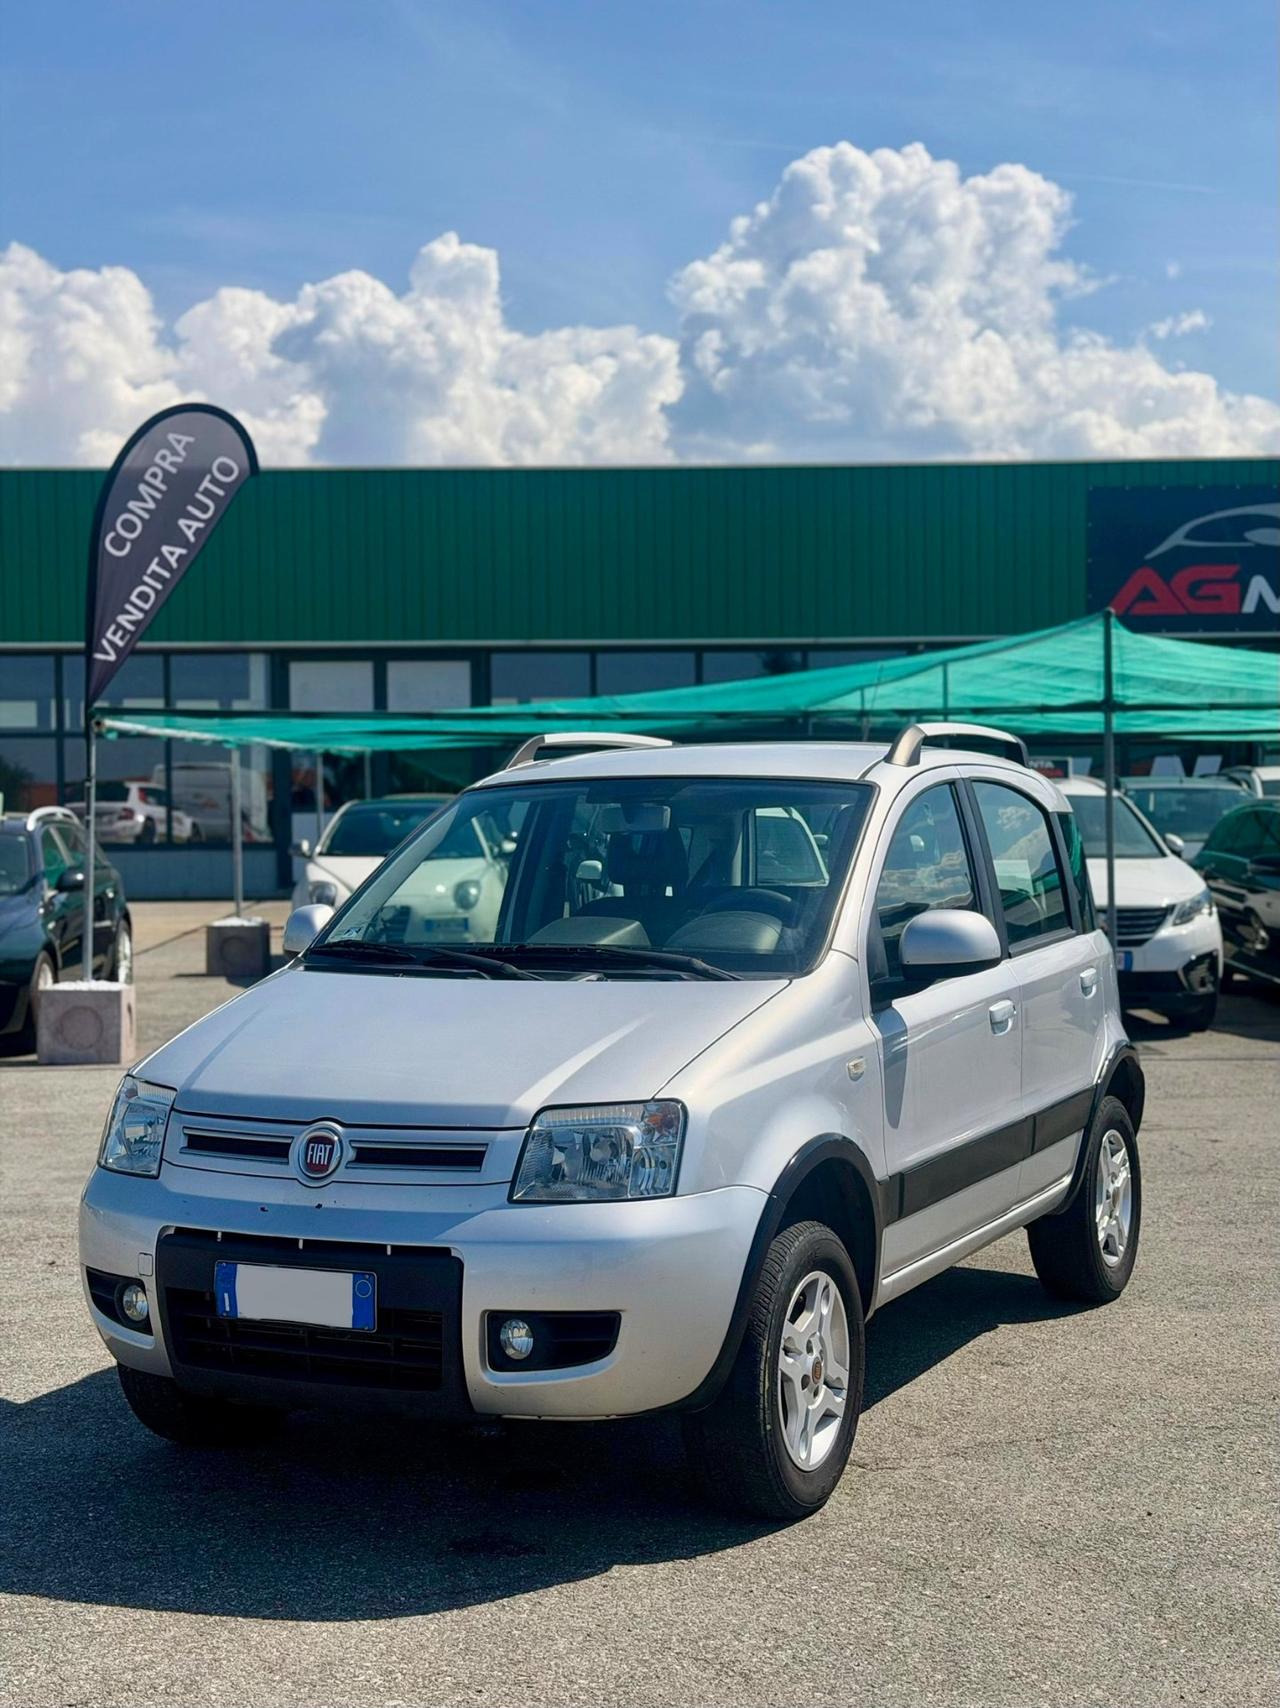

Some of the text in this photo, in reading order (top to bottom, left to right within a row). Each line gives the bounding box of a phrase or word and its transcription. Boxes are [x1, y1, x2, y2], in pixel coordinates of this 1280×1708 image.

[104, 431, 195, 558] COMPRA
[93, 456, 240, 663] VENDITA AUTO
[307, 1143, 332, 1165] FIAT
